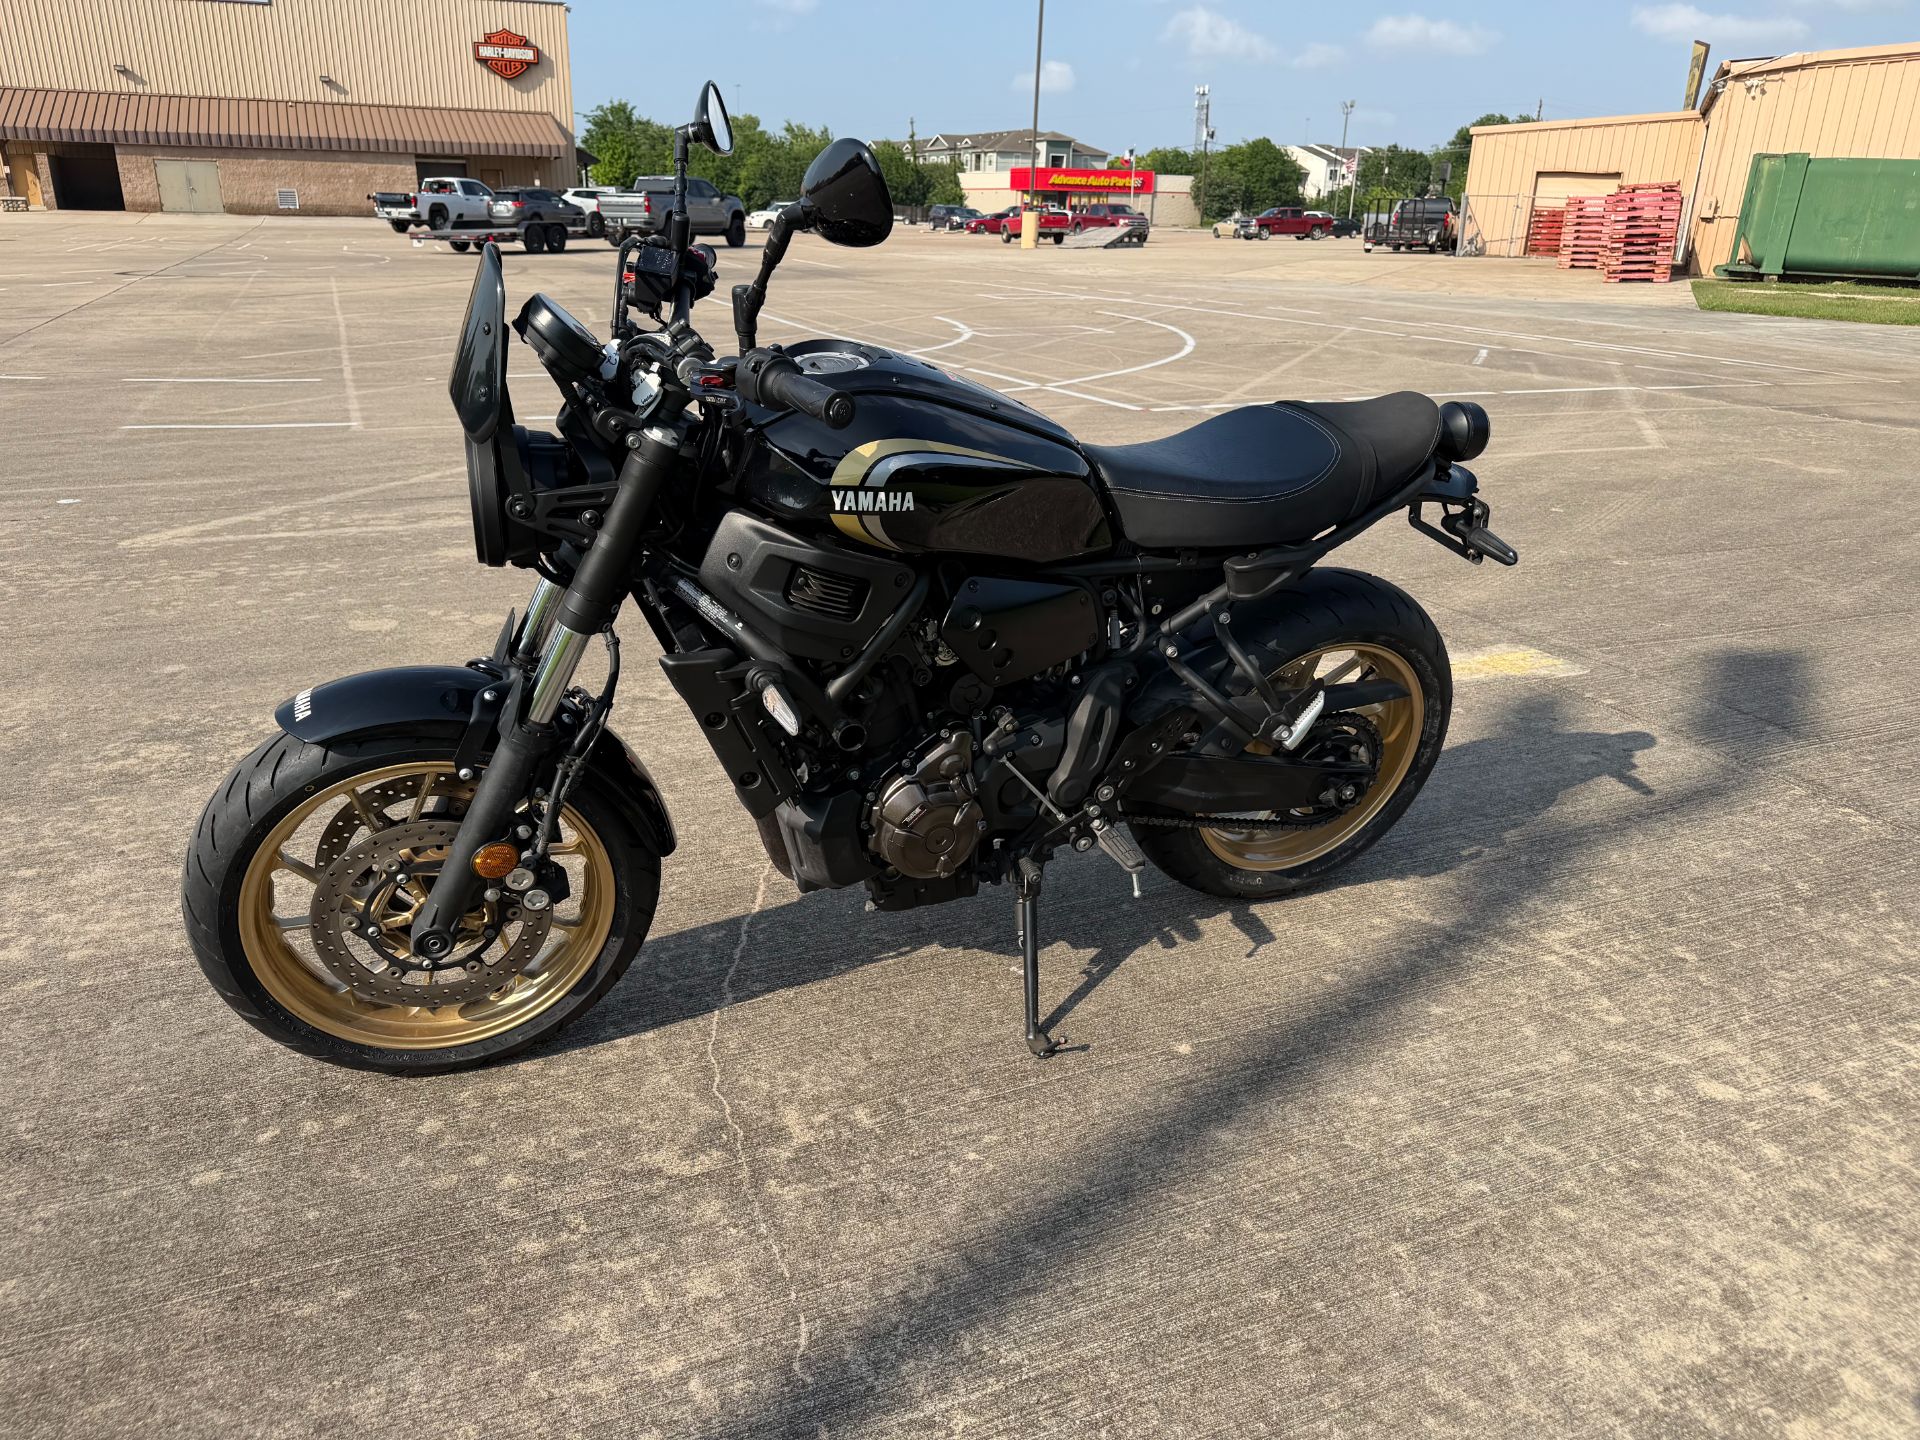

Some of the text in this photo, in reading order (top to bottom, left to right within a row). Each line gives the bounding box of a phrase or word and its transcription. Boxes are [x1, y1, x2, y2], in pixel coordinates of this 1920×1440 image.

[491, 35, 520, 46] MOTOR
[478, 45, 535, 60] HARLEY-DAVIDSON
[491, 60, 522, 74] CYCLES
[1048, 174, 1087, 185] Advance
[1087, 176, 1110, 186] Auto
[831, 490, 914, 511] YAMAHA
